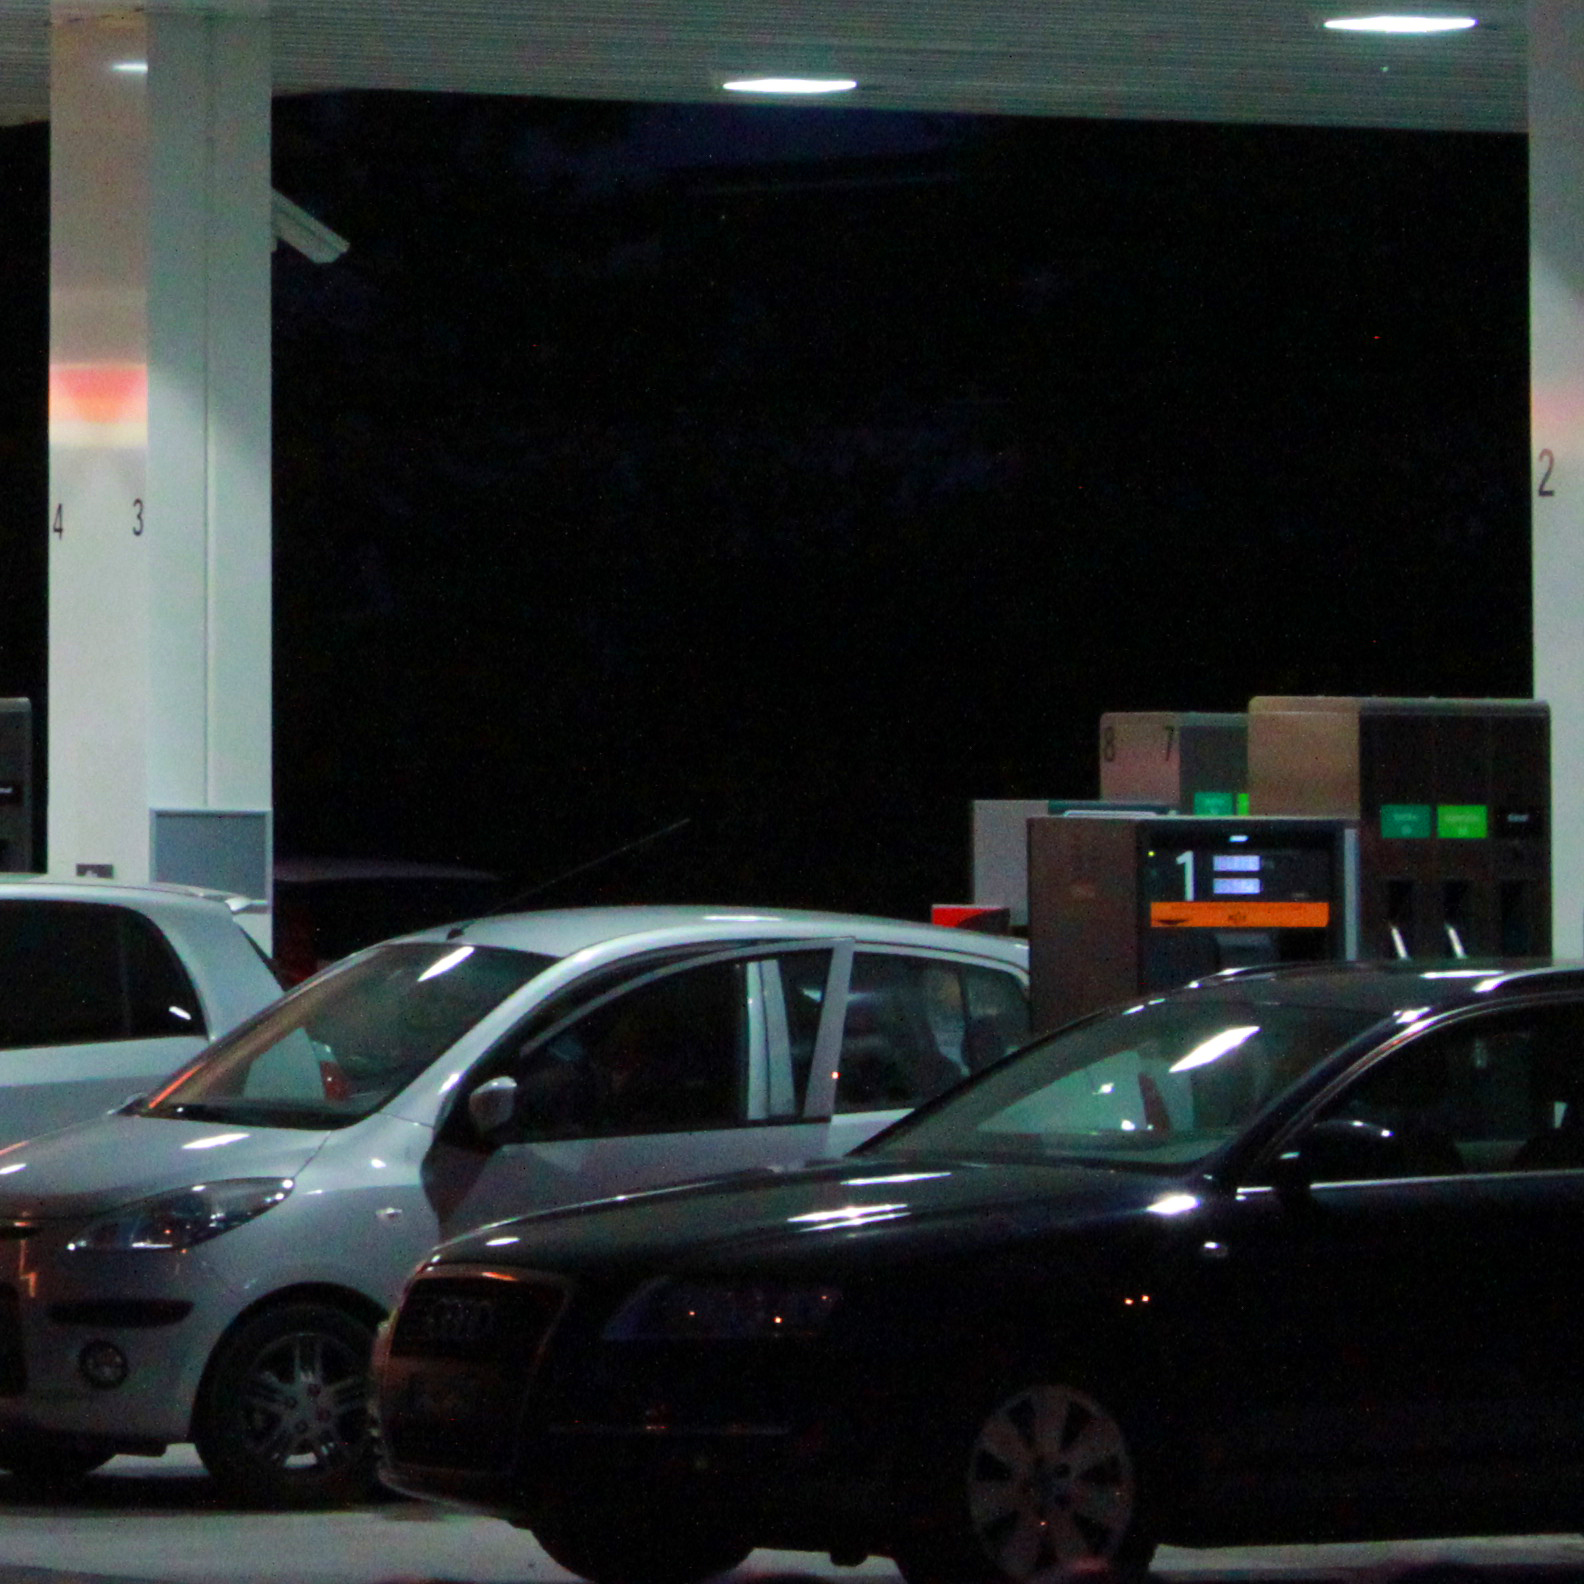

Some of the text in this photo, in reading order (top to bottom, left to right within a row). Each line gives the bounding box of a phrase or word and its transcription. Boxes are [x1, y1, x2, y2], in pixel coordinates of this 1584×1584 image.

[1539, 448, 1555, 496] 2
[53, 503, 63, 539] 4
[133, 499, 144, 536] 3
[1103, 726, 1116, 762] 8
[1164, 725, 1175, 762] 7
[1175, 850, 1195, 902] 1
